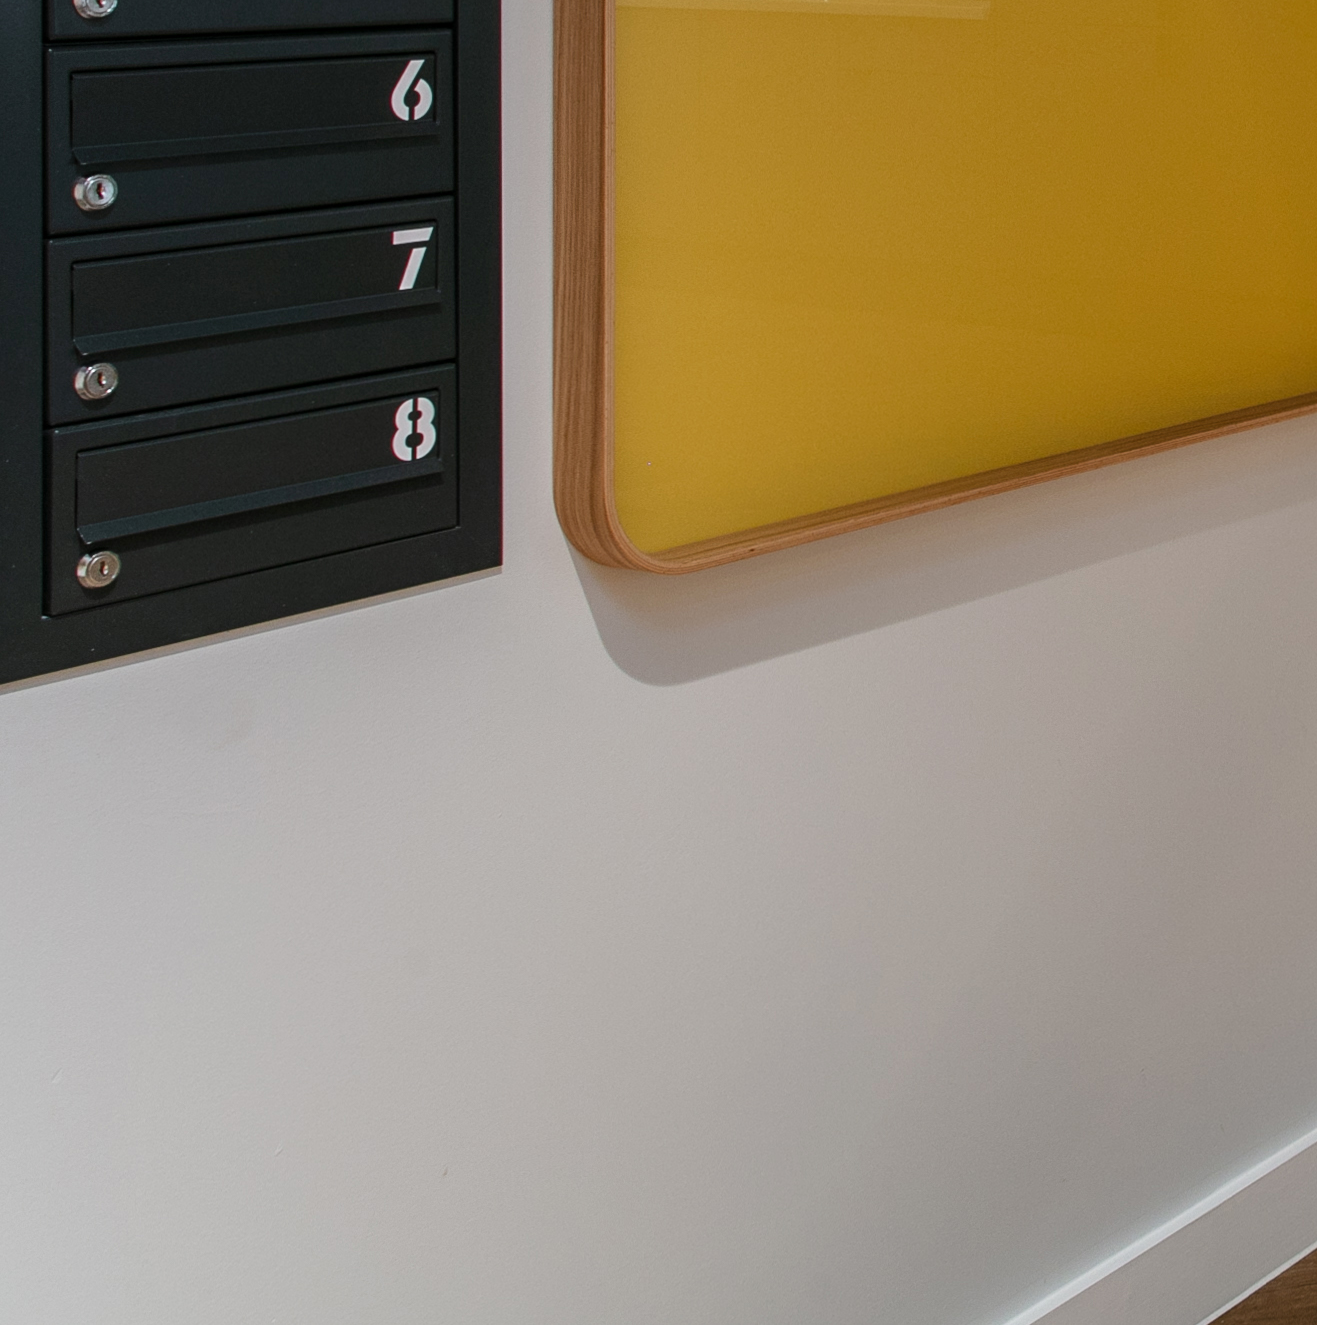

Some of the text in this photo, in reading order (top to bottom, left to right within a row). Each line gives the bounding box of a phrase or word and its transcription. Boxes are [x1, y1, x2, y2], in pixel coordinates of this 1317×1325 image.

[391, 59, 432, 121] 6
[393, 227, 433, 290] 7
[392, 397, 436, 461] 8
